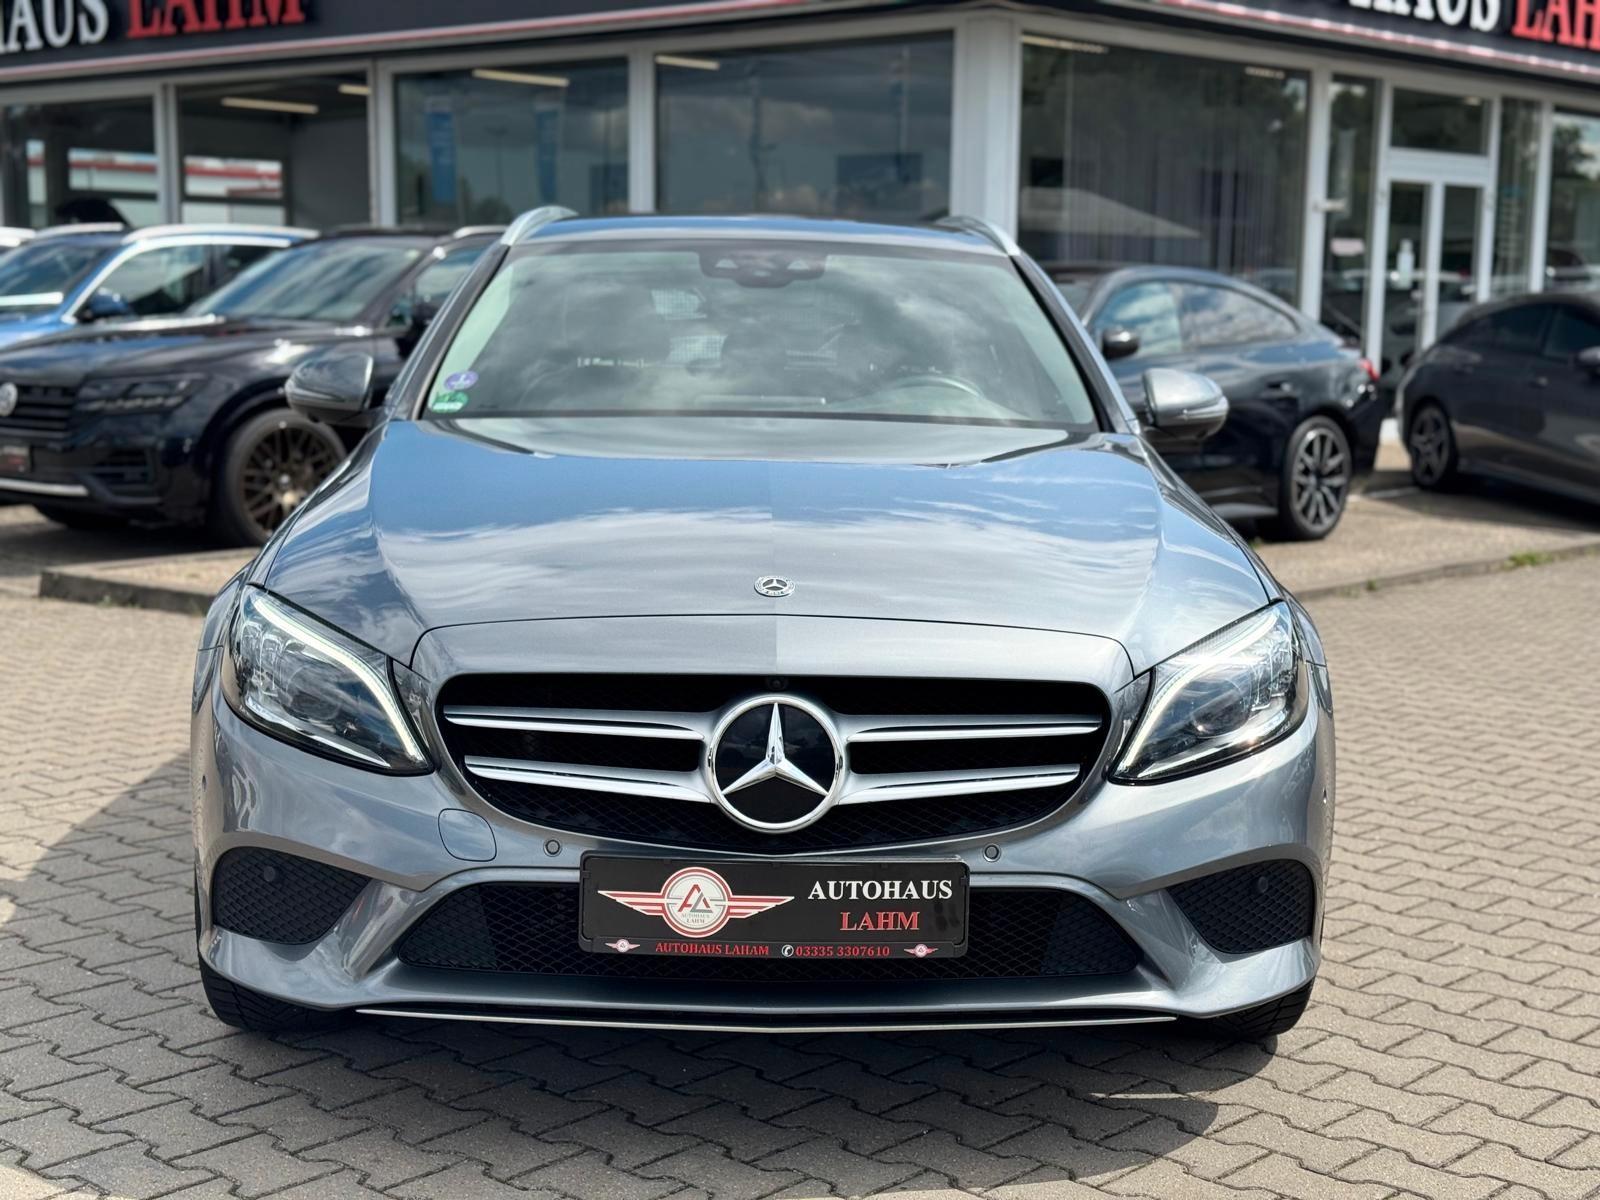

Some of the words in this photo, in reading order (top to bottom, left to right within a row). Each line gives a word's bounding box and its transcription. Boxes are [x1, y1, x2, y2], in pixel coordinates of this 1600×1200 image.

[807, 880, 953, 900] AUTOHAUS
[840, 911, 920, 931] LAHM
[655, 942, 722, 954] AUTOHAUS
[725, 944, 769, 956] LAHAM
[796, 946, 834, 957] 03335
[836, 946, 891, 957] 3307610
